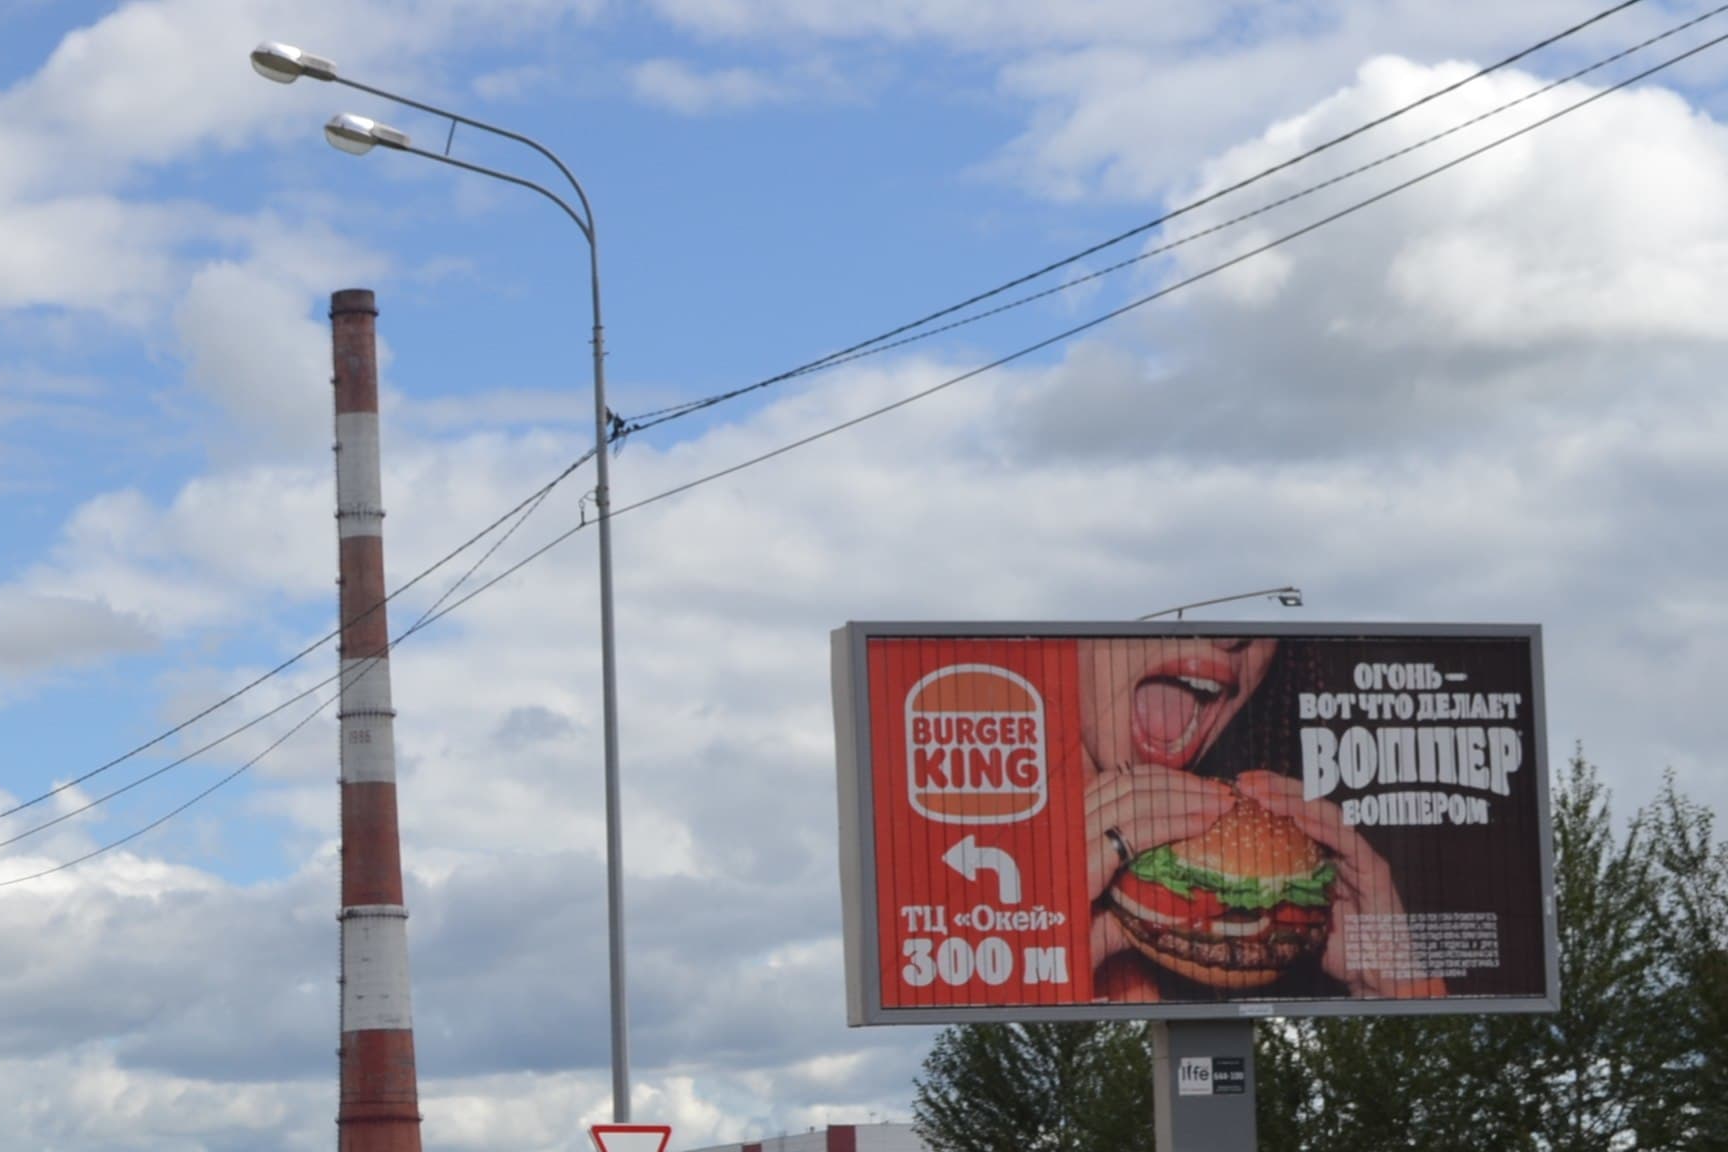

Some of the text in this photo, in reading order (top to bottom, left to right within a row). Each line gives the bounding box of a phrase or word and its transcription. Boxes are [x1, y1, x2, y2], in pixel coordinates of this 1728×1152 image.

[1353, 662, 1442, 690] ОГОНЬ
[1299, 692, 1522, 721] ВОТ ЧТО ДЕЛАЕТ
[912, 716, 1037, 745] BURGER
[914, 747, 1040, 789] KING
[1300, 725, 1523, 802] ВОППЕР
[1342, 791, 1490, 826] ВОППЕРОМ
[901, 904, 1067, 935] ТЦ «Окей»
[902, 936, 1013, 987] 300
